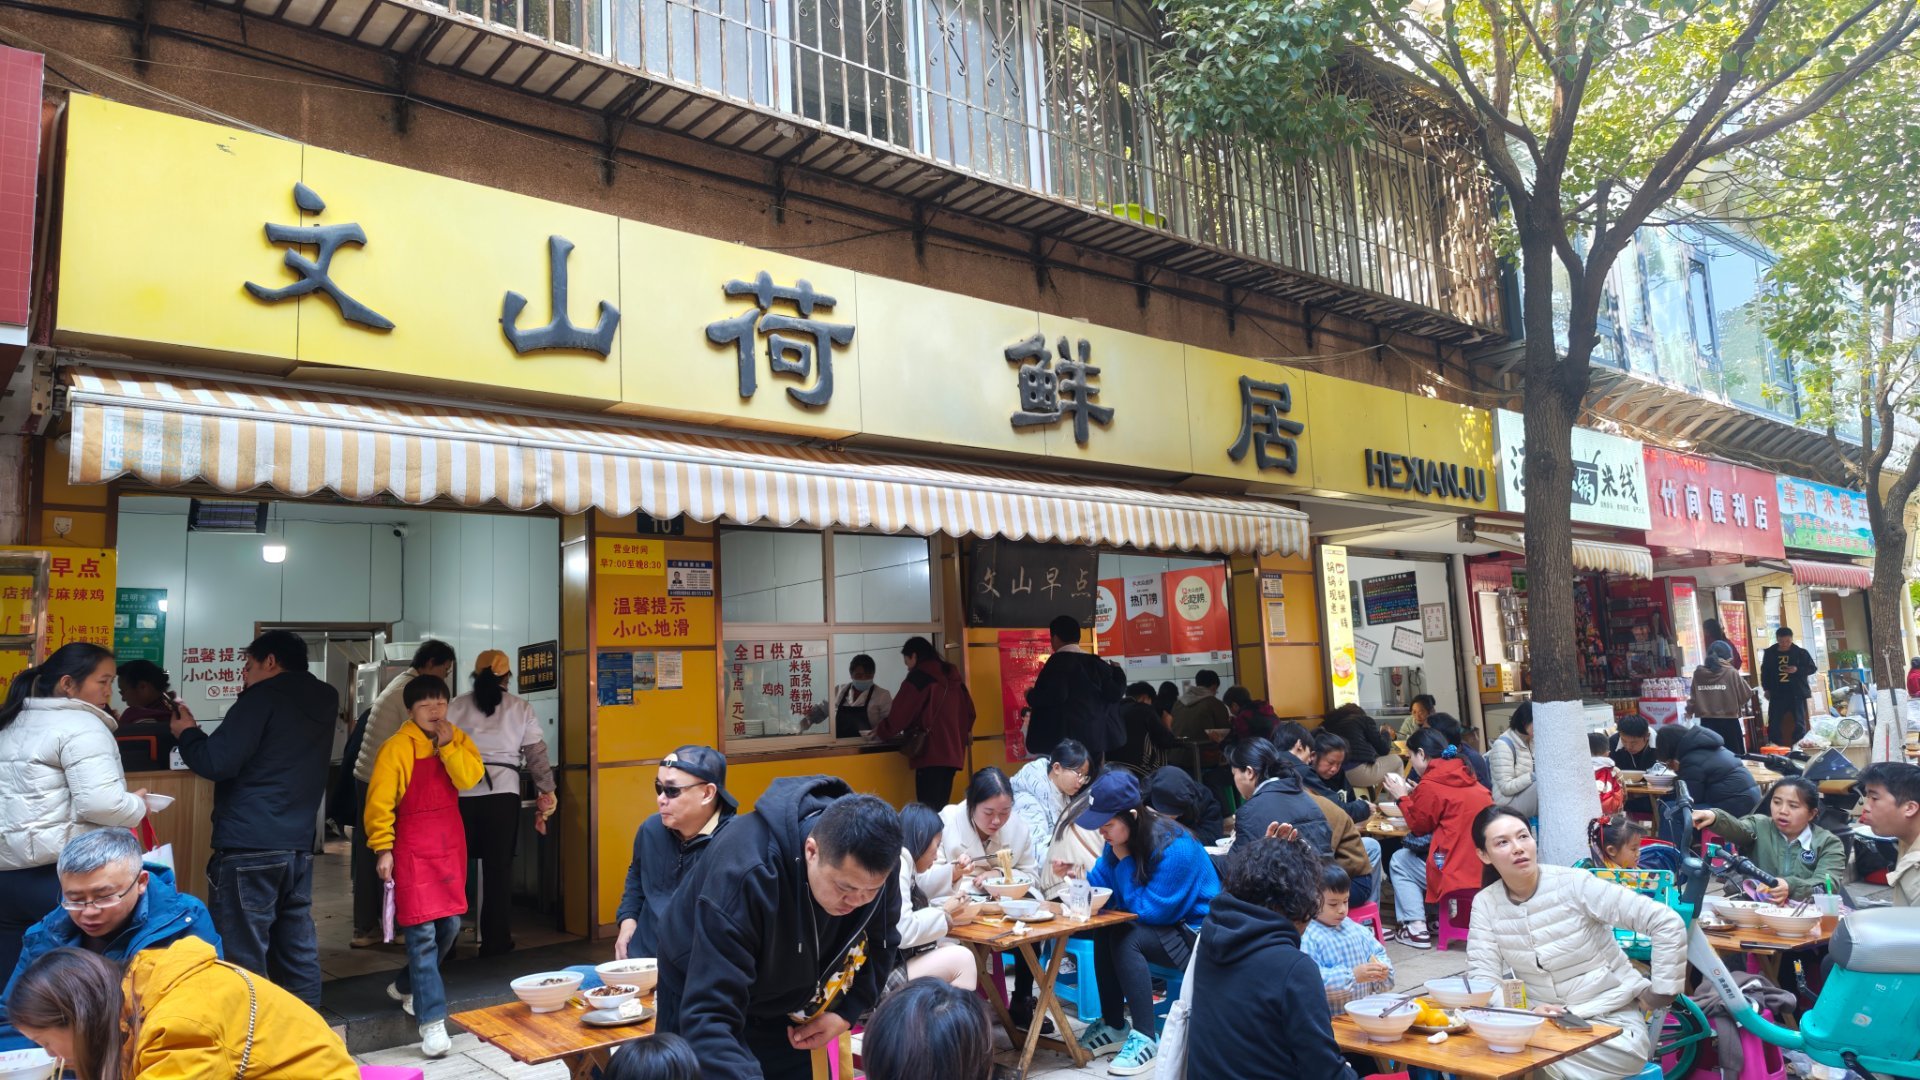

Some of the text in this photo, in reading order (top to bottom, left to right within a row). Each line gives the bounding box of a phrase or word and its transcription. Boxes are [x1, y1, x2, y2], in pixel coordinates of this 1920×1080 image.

[243, 181, 1304, 474] 文山荷鲜居
[1365, 448, 1486, 502] HEXIANJU
[1659, 478, 1769, 531] 竹间便利店
[613, 543, 648, 555] 营业时间
[50, 557, 101, 578] 早点
[600, 558, 662, 570] 早7:00至晚8:30
[979, 567, 1093, 600] 文山早点
[613, 596, 686, 616] 温馨提示
[1130, 593, 1158, 607] 热门榜
[613, 619, 690, 638] 小心地滑
[183, 647, 249, 663] 温馨提示
[734, 643, 804, 660] 全日供应
[789, 660, 812, 673] 米线
[732, 663, 745, 691] 早点
[790, 674, 812, 687] 面条
[222, 685, 243, 693] 禁止吸
[762, 682, 784, 696] 鸡肉
[790, 689, 813, 701] 卷粉
